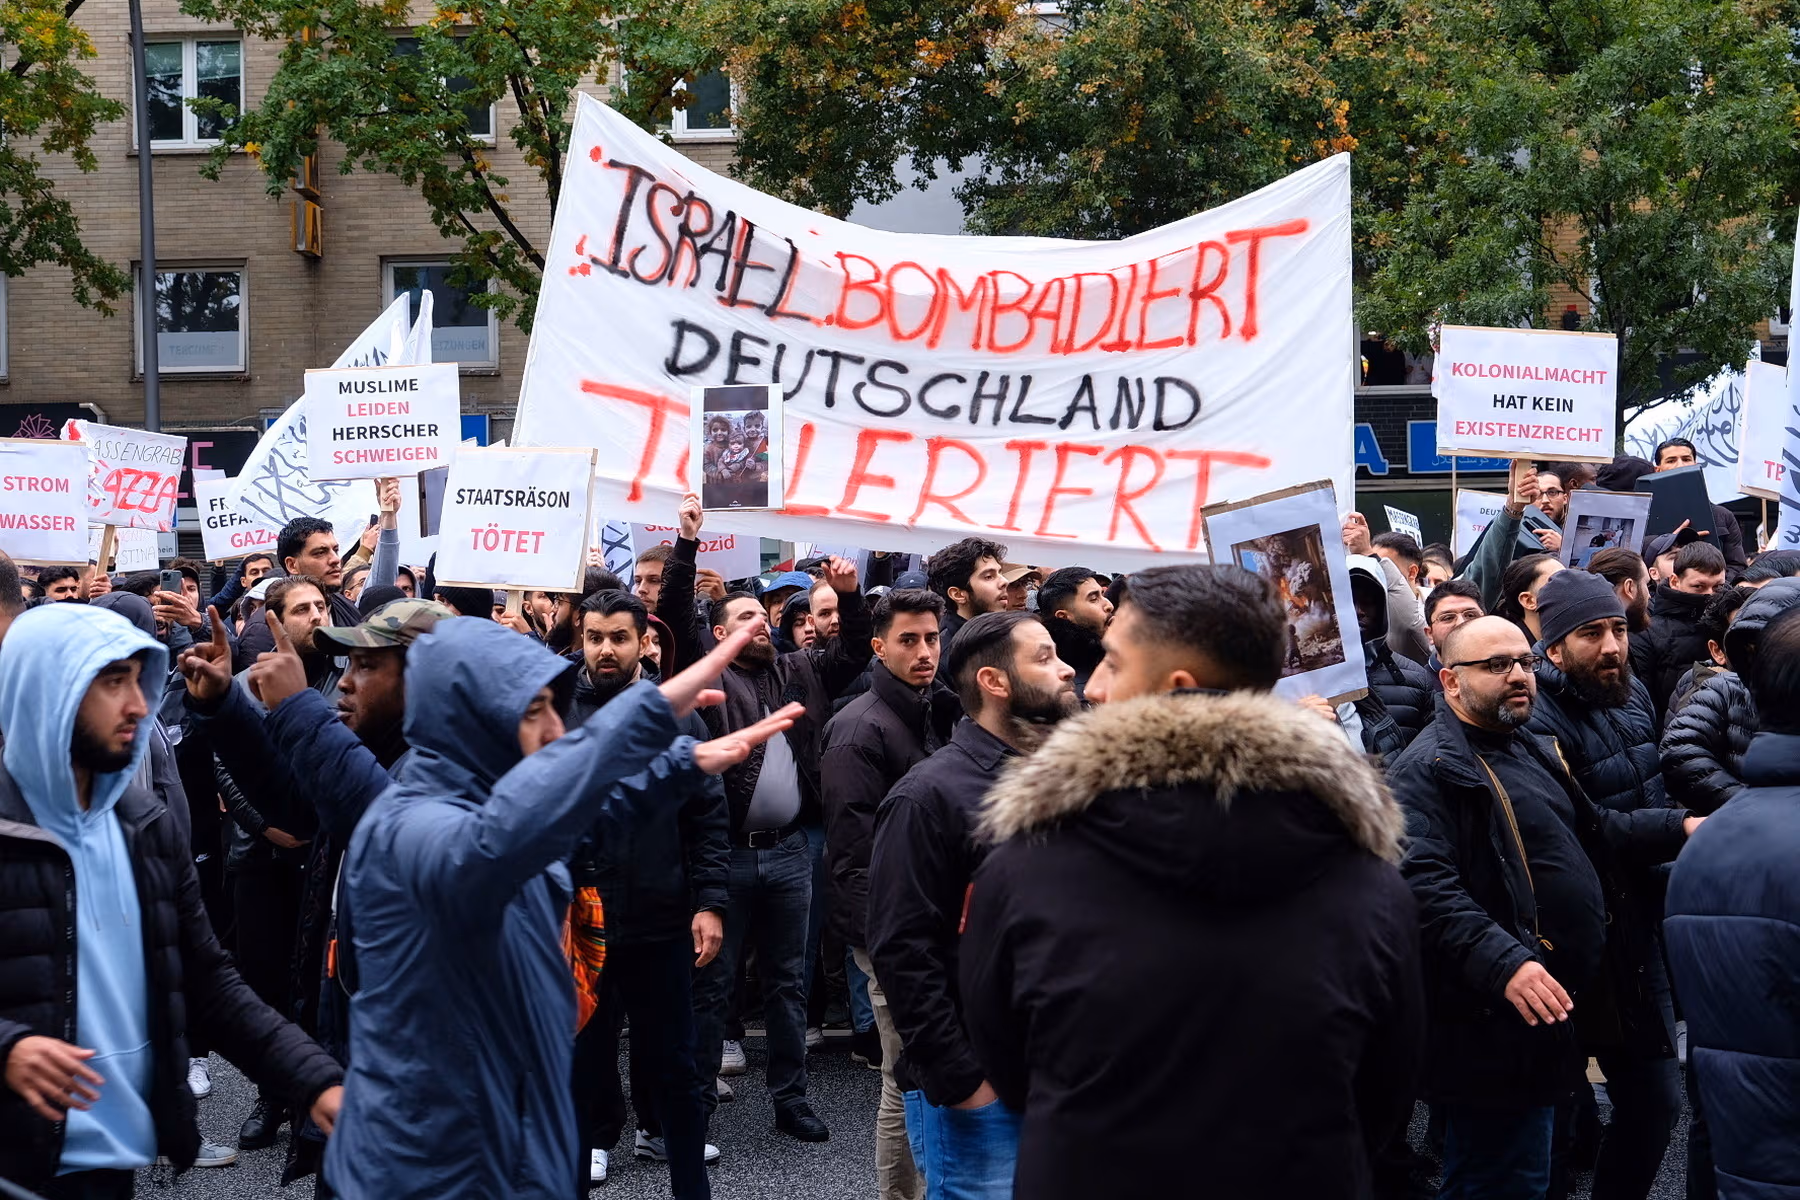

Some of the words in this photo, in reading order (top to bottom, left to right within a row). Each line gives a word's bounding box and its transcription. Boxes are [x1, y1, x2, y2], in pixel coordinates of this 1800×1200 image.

[588, 158, 824, 327] ISRAEL
[834, 217, 1309, 355] BOMBADIERT
[664, 318, 1202, 432] DEUTSCHLAND
[1452, 362, 1608, 385] KOLONIALMACHT
[338, 378, 419, 395] MUSLIME
[347, 401, 410, 417] LEIDEN
[1493, 393, 1527, 410] HAT
[1532, 396, 1574, 413] KEIN
[332, 423, 439, 441] HERRSCHER
[1455, 420, 1603, 443] EXISTENZRECHT
[94, 439, 182, 465] ASSENGRAB
[333, 446, 438, 464] SCHWEIGEN
[580, 379, 1272, 554] TLERIERT
[3, 475, 69, 493] STROM
[94, 467, 179, 517] AZZA
[455, 486, 570, 508] STAATSRÄSON
[0, 513, 75, 531] WASSER
[471, 523, 545, 554] TÖTET
